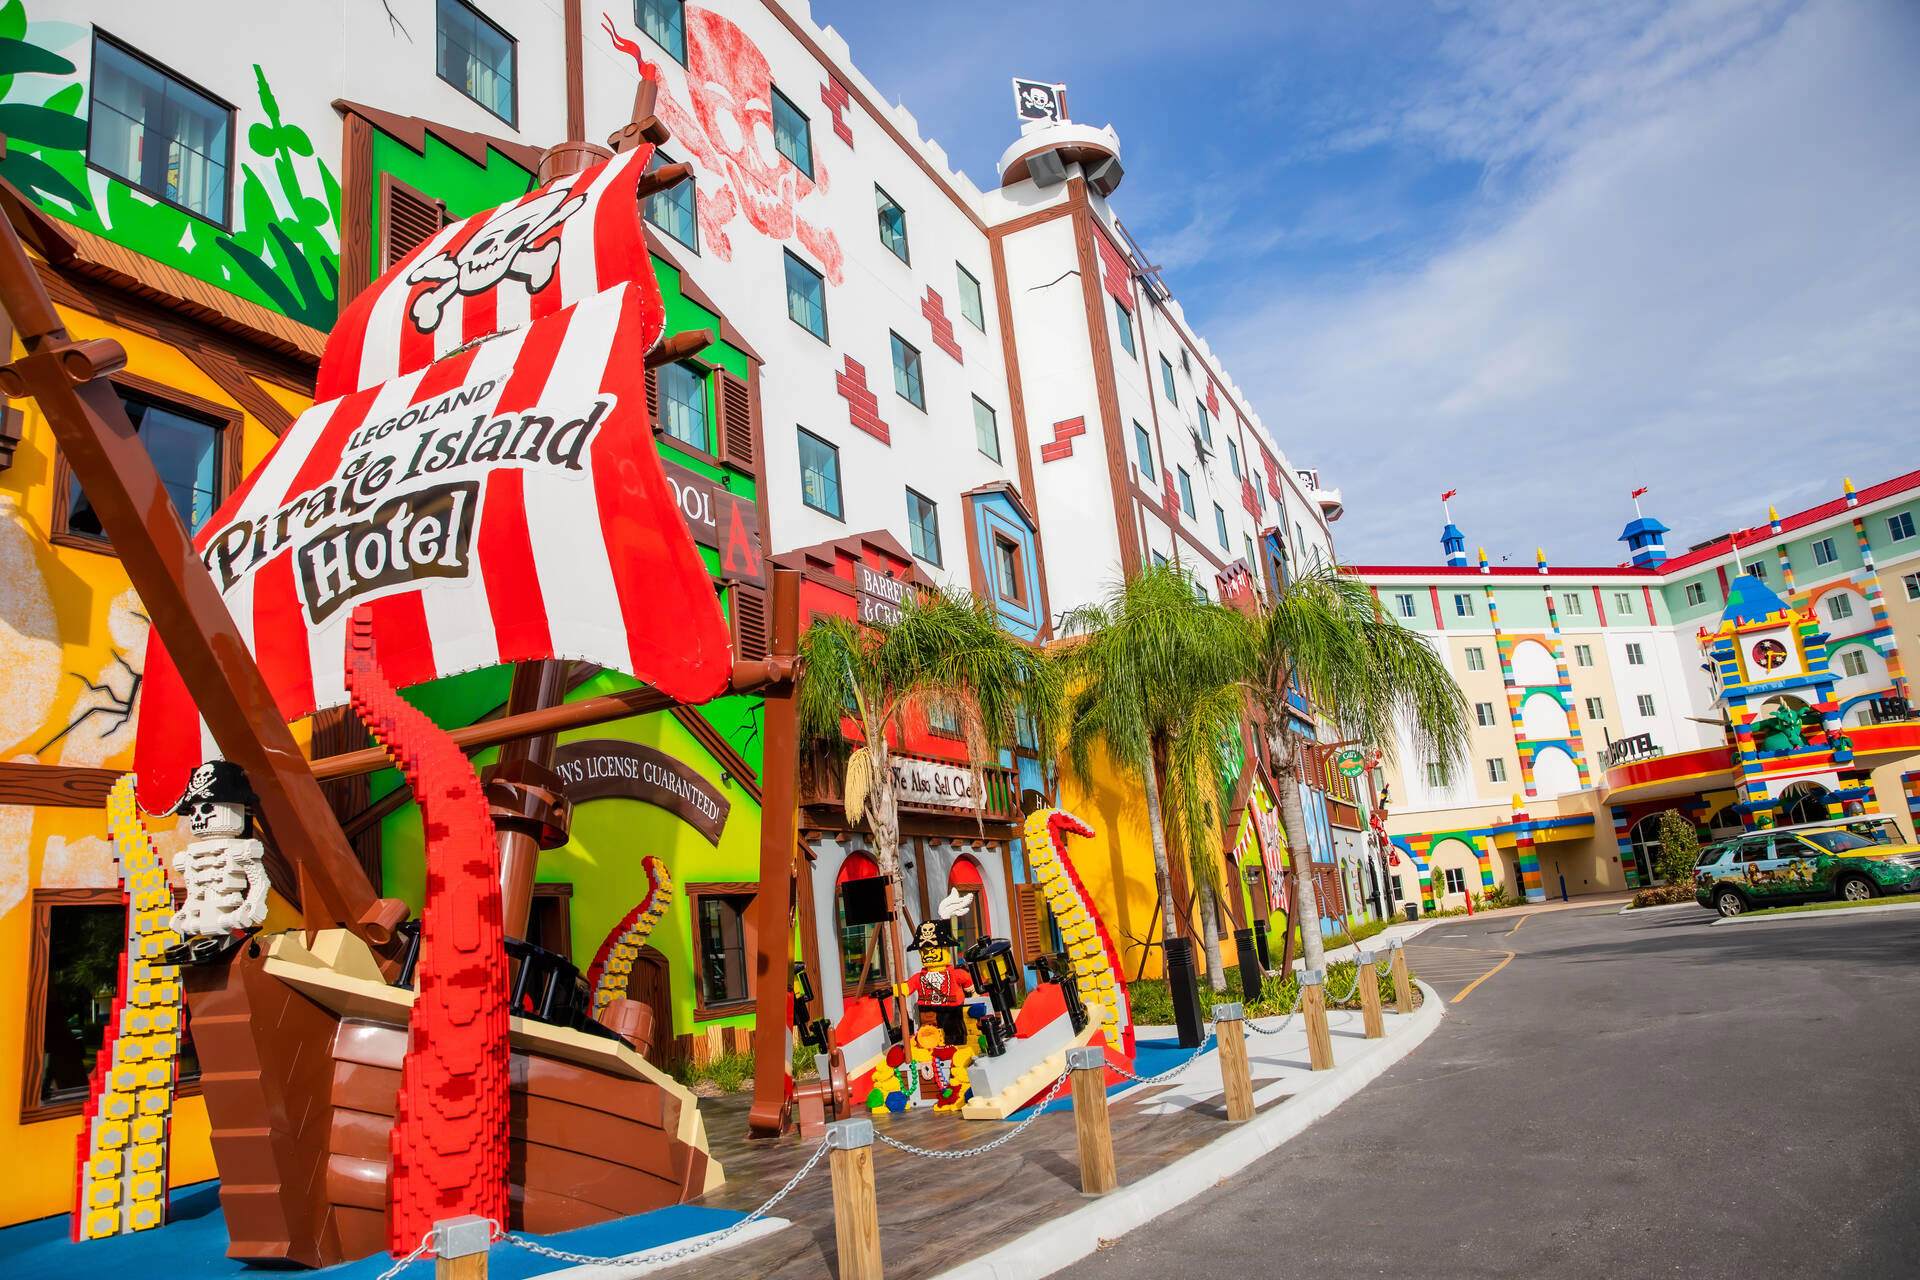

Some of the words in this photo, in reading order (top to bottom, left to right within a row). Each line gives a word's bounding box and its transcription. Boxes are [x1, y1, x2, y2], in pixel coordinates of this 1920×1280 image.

[348, 380, 497, 451] LEGOLAND
[204, 451, 396, 595] Pirate
[396, 401, 608, 484] Island
[307, 491, 468, 608] Hotel
[586, 755, 639, 780] LICENSE
[643, 761, 721, 824] GUARANTEED!
[891, 767, 907, 791] We
[911, 769, 931, 795] Also
[934, 773, 951, 797] Sell
